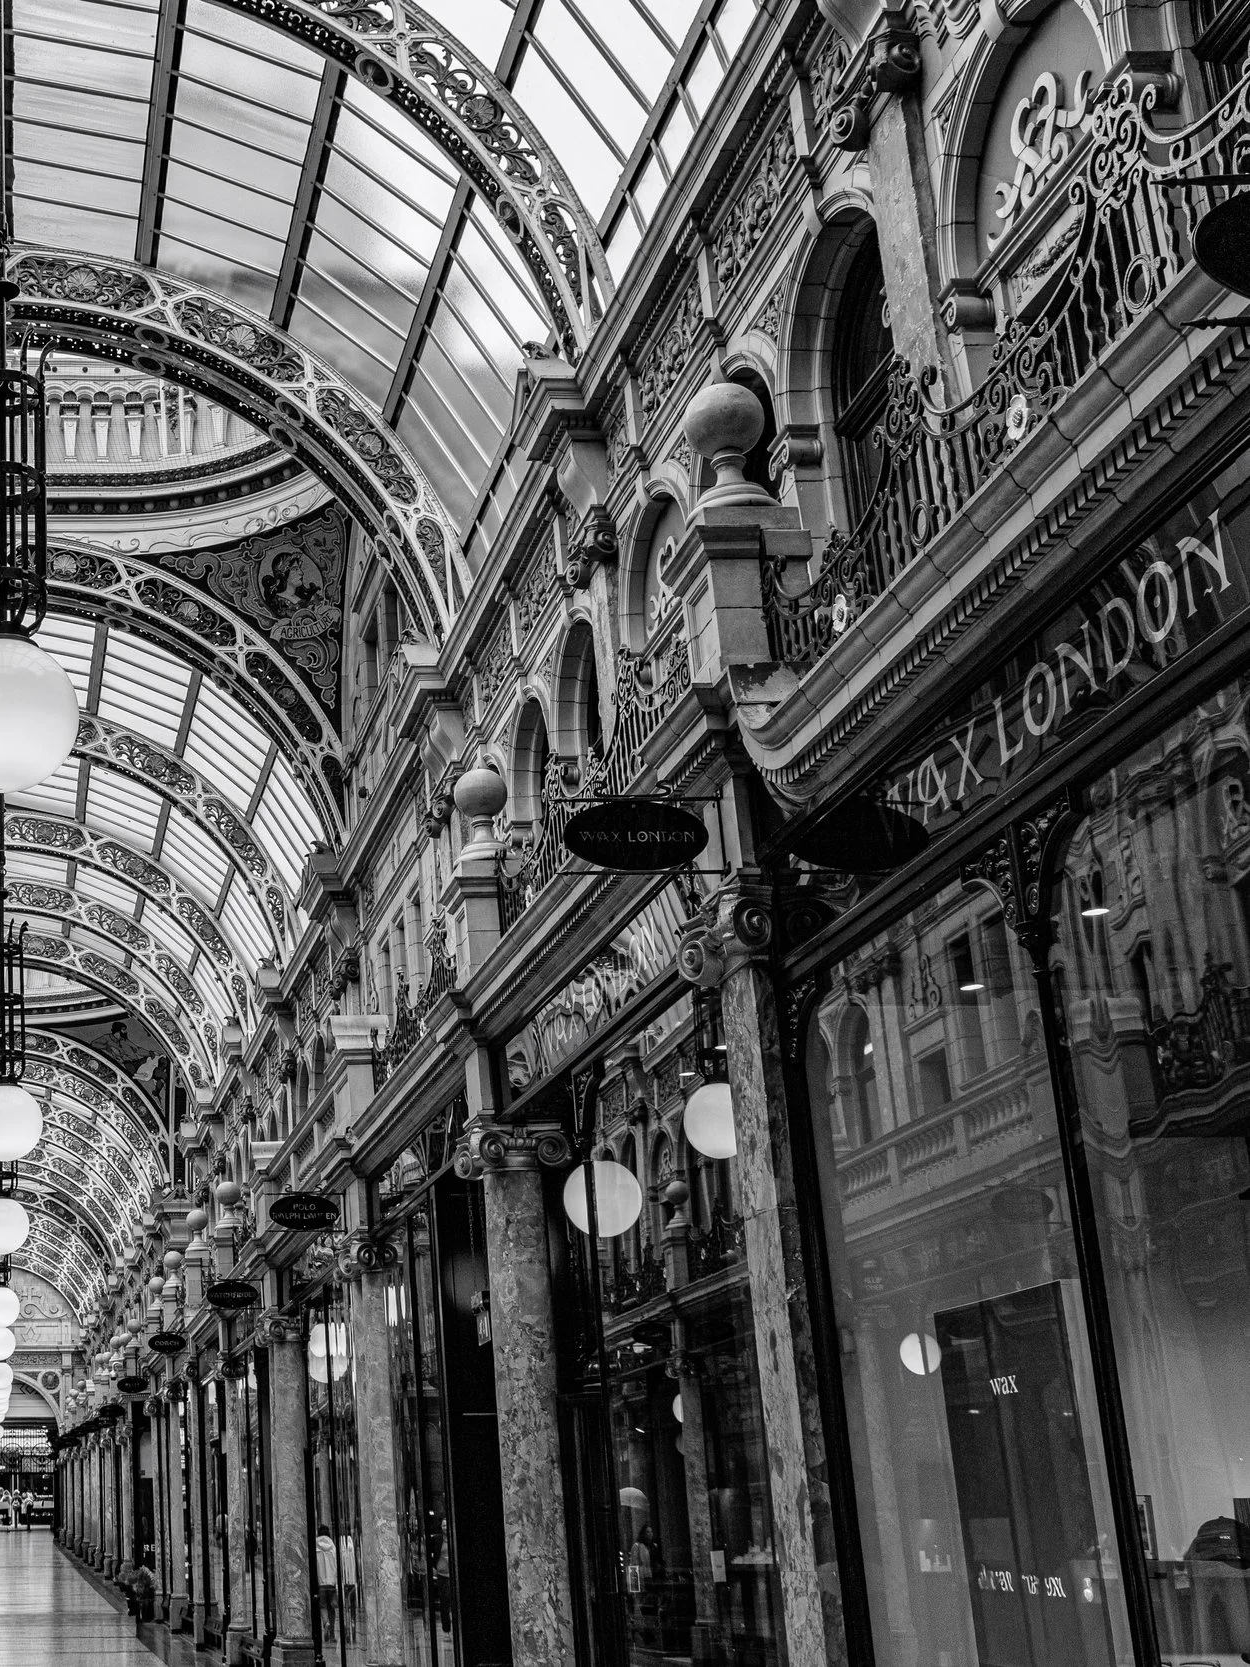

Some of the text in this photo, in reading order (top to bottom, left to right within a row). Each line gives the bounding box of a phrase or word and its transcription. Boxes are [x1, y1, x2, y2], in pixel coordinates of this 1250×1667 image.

[281, 612, 333, 639] AGRICULTURE
[993, 508, 1232, 767] LONDON
[579, 831, 695, 843] WAX LONDON
[293, 1203, 316, 1211] POLO
[989, 1374, 1019, 1396] wax
